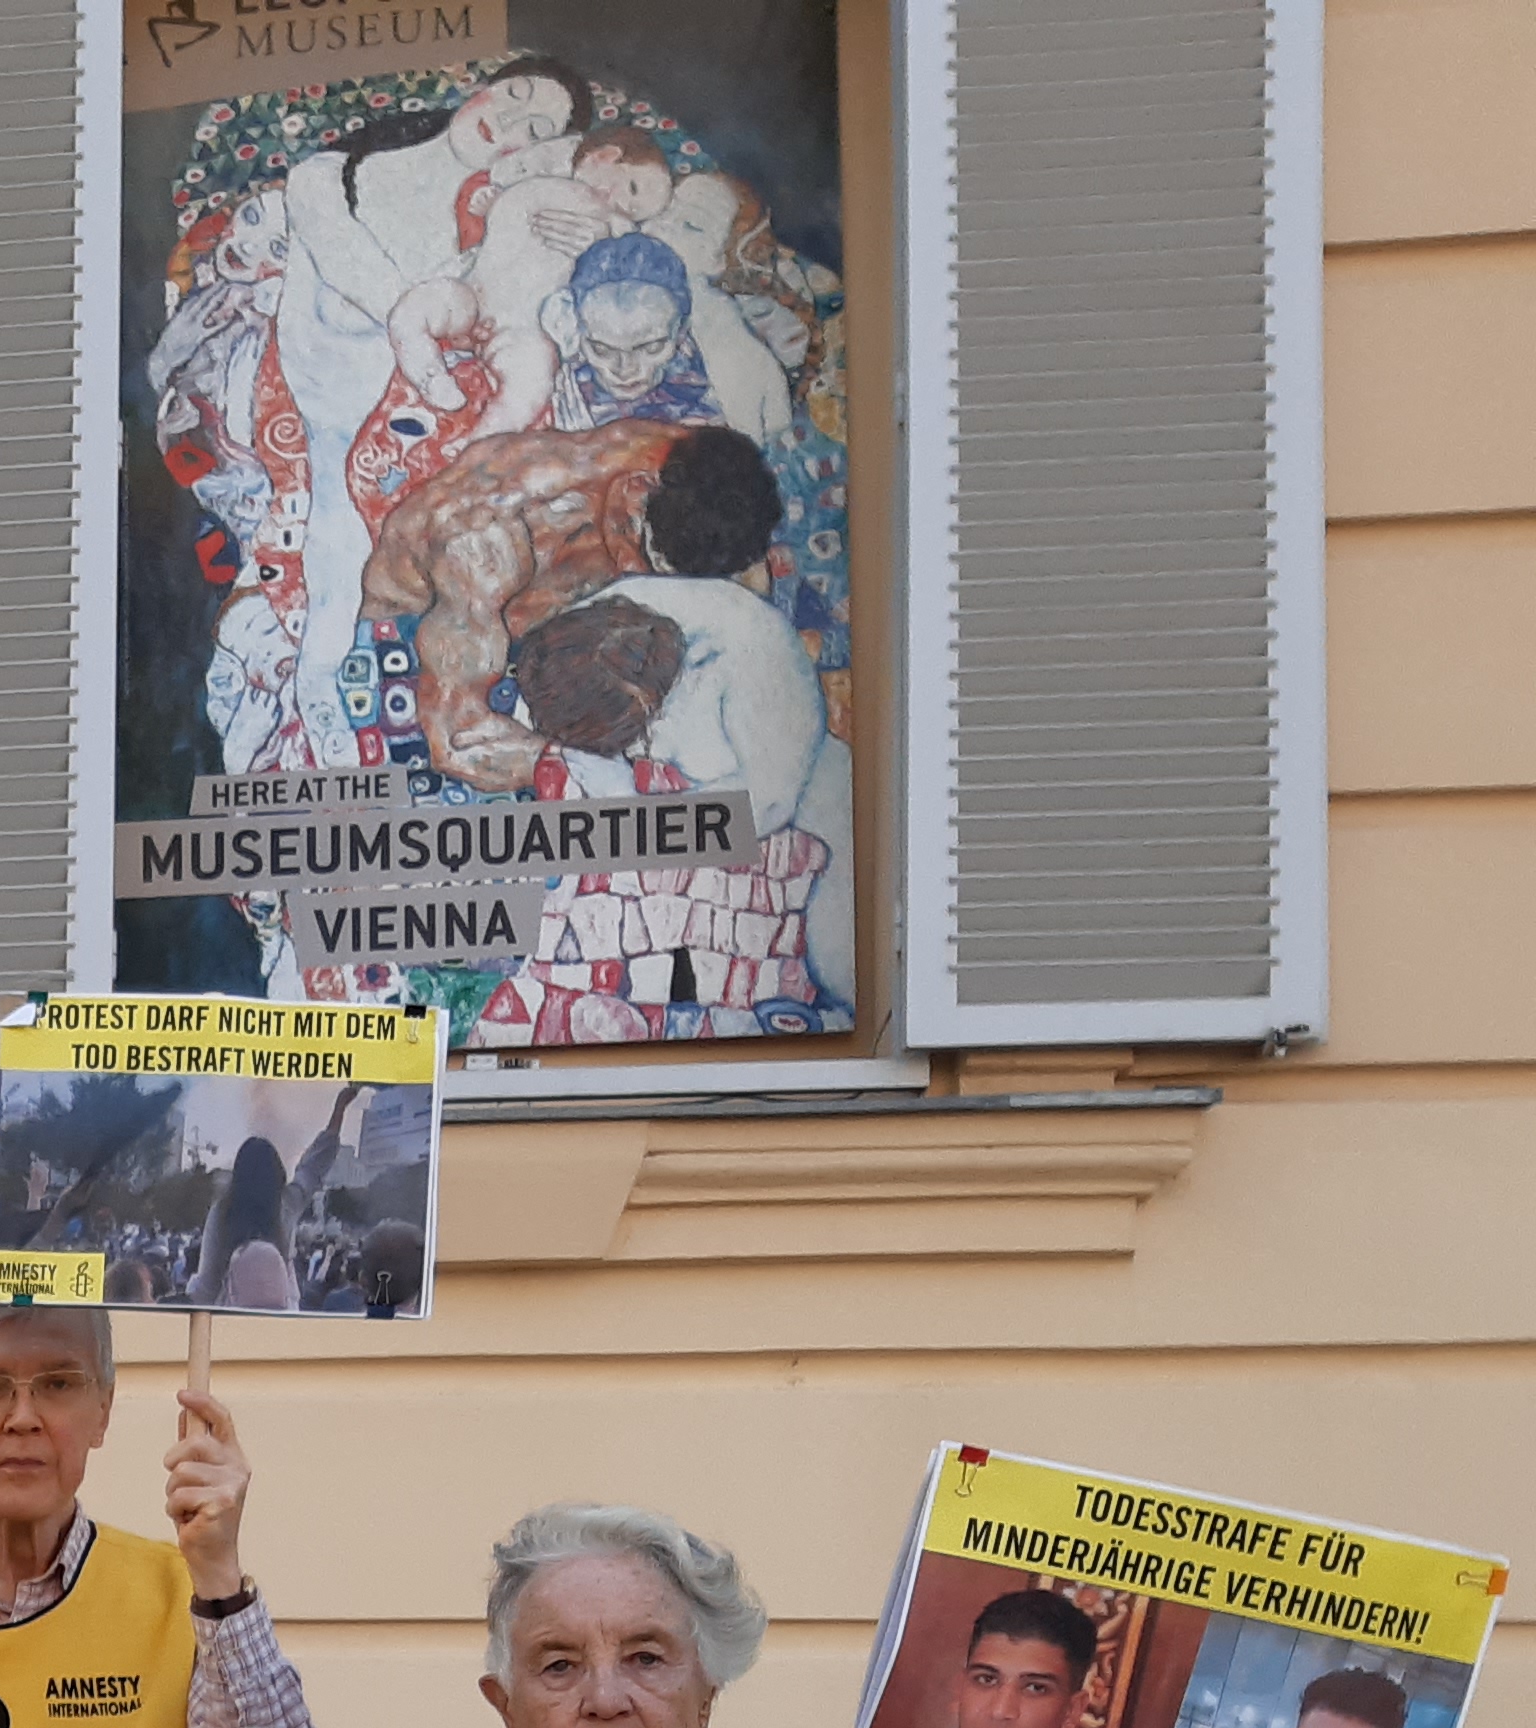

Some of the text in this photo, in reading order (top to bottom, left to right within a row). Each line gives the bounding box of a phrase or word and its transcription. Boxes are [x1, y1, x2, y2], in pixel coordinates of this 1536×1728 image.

[236, 5, 474, 59] MUSEUM
[212, 773, 391, 809] HERE AT THE
[141, 802, 733, 885] MUSEUMSQUARTIER
[314, 899, 518, 954] VIENNA
[146, 1006, 209, 1033] DARF
[218, 1008, 285, 1038] NICHT
[293, 1012, 337, 1039] MIT
[345, 1013, 396, 1041] DEM
[71, 1043, 354, 1079] TOD BESTRAFT WERDEN
[1073, 1482, 1367, 1578] TODESSTRAFE FÜR
[961, 1516, 1432, 1645] MINDERJÄHRIGE VERHINDERN!
[45, 1675, 141, 1700] AMNESTY
[47, 1697, 142, 1718] INTERNATIONAL
